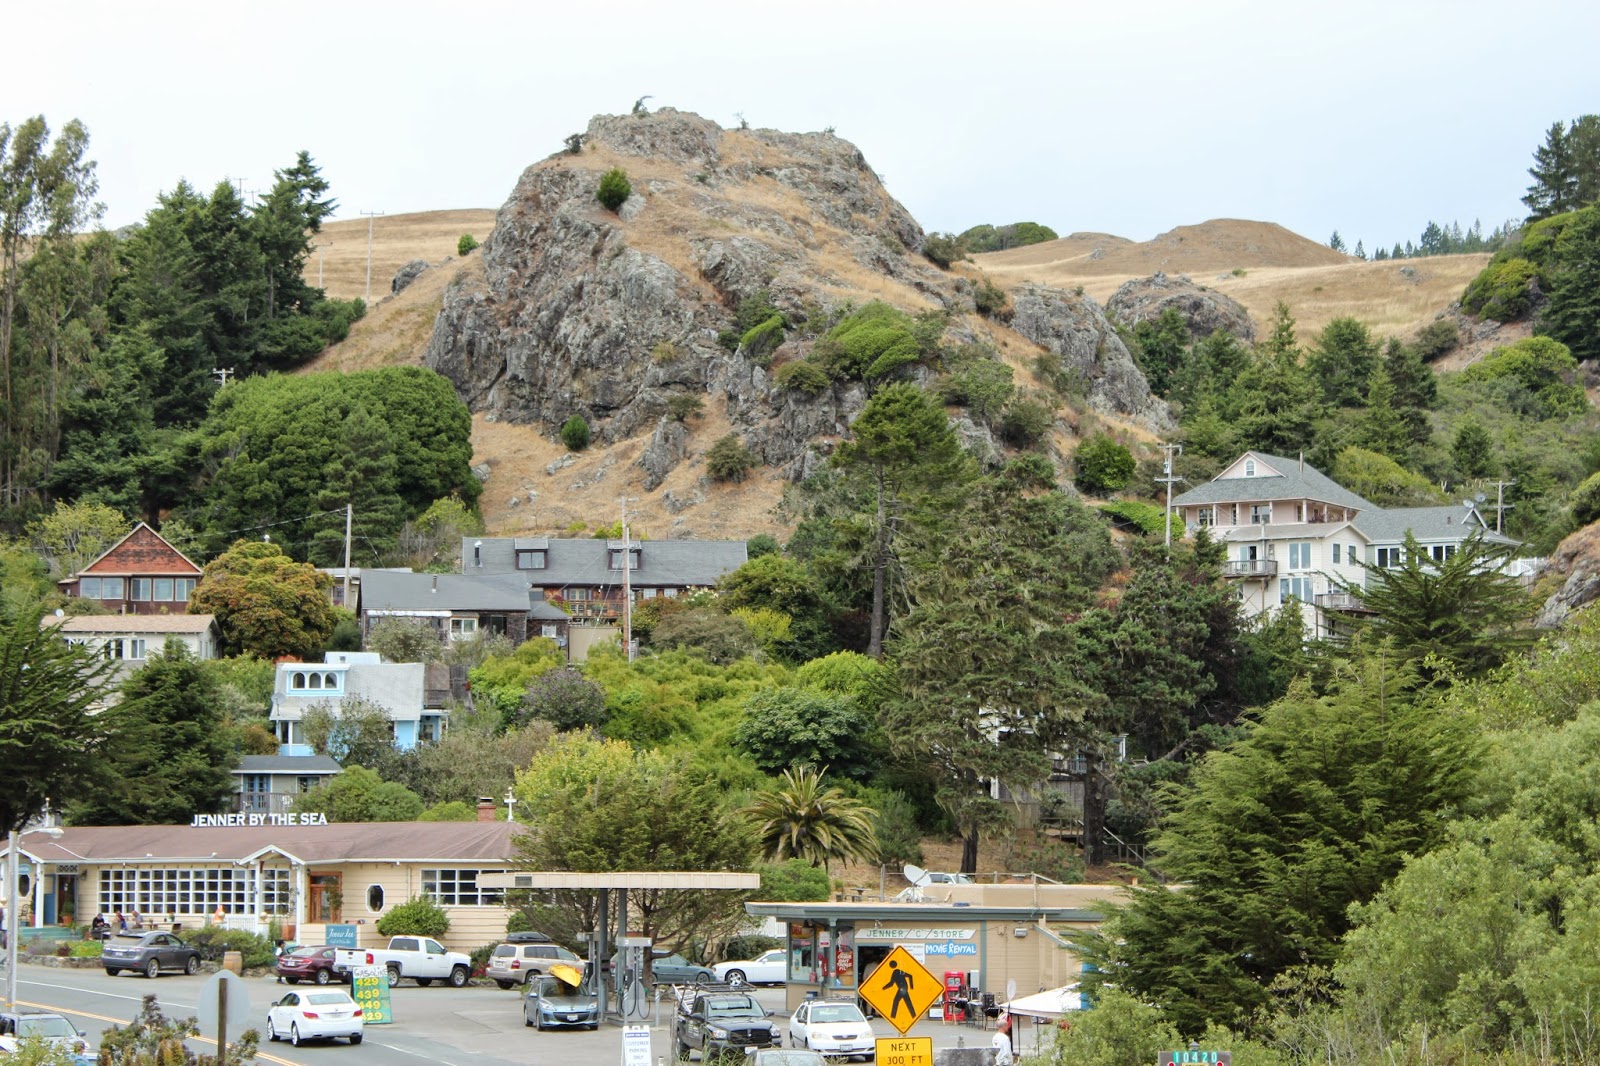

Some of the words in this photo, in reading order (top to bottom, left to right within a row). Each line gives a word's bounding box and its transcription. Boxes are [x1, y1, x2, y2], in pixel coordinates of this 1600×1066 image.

[191, 814, 246, 827] JENNER
[249, 813, 267, 826] BY
[269, 812, 297, 826] THE
[300, 812, 328, 826] SEA
[866, 929, 904, 938] JENNER
[933, 929, 964, 938] STORE
[925, 944, 947, 954] MOVIE
[948, 943, 976, 954] RENTAL
[356, 977, 379, 987] 429
[356, 988, 380, 999] 439
[358, 1000, 381, 1010] 449
[891, 1042, 916, 1052] NEXT
[887, 1056, 905, 1065] 300
[911, 1055, 923, 1064] FT
[1175, 1051, 1217, 1063] 10420
